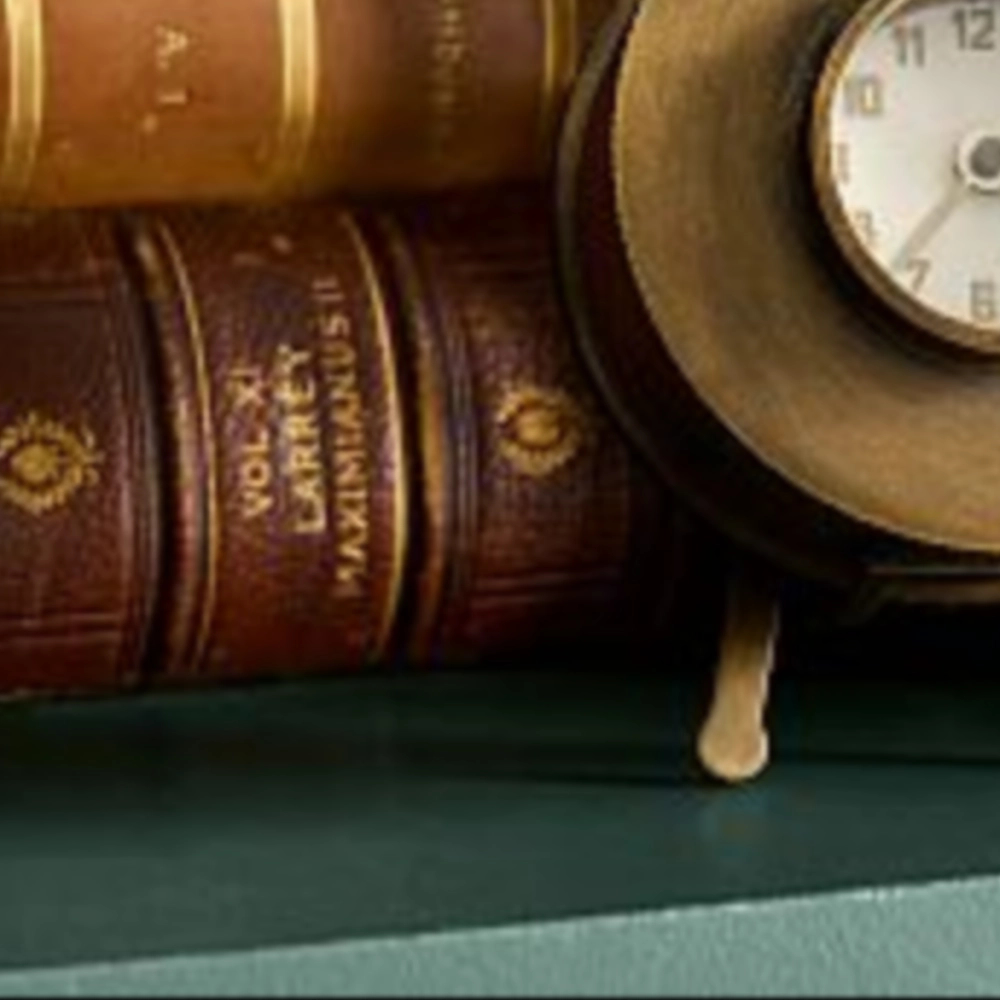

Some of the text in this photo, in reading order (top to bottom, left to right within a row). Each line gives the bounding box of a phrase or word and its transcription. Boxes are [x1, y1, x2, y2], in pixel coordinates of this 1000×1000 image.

[895, 23, 926, 67] 11
[954, 8, 996, 50] 12
[906, 257, 932, 292] 7
[969, 277, 997, 322] 6
[274, 344, 326, 533] LARREY
[241, 430, 273, 518] VOL
